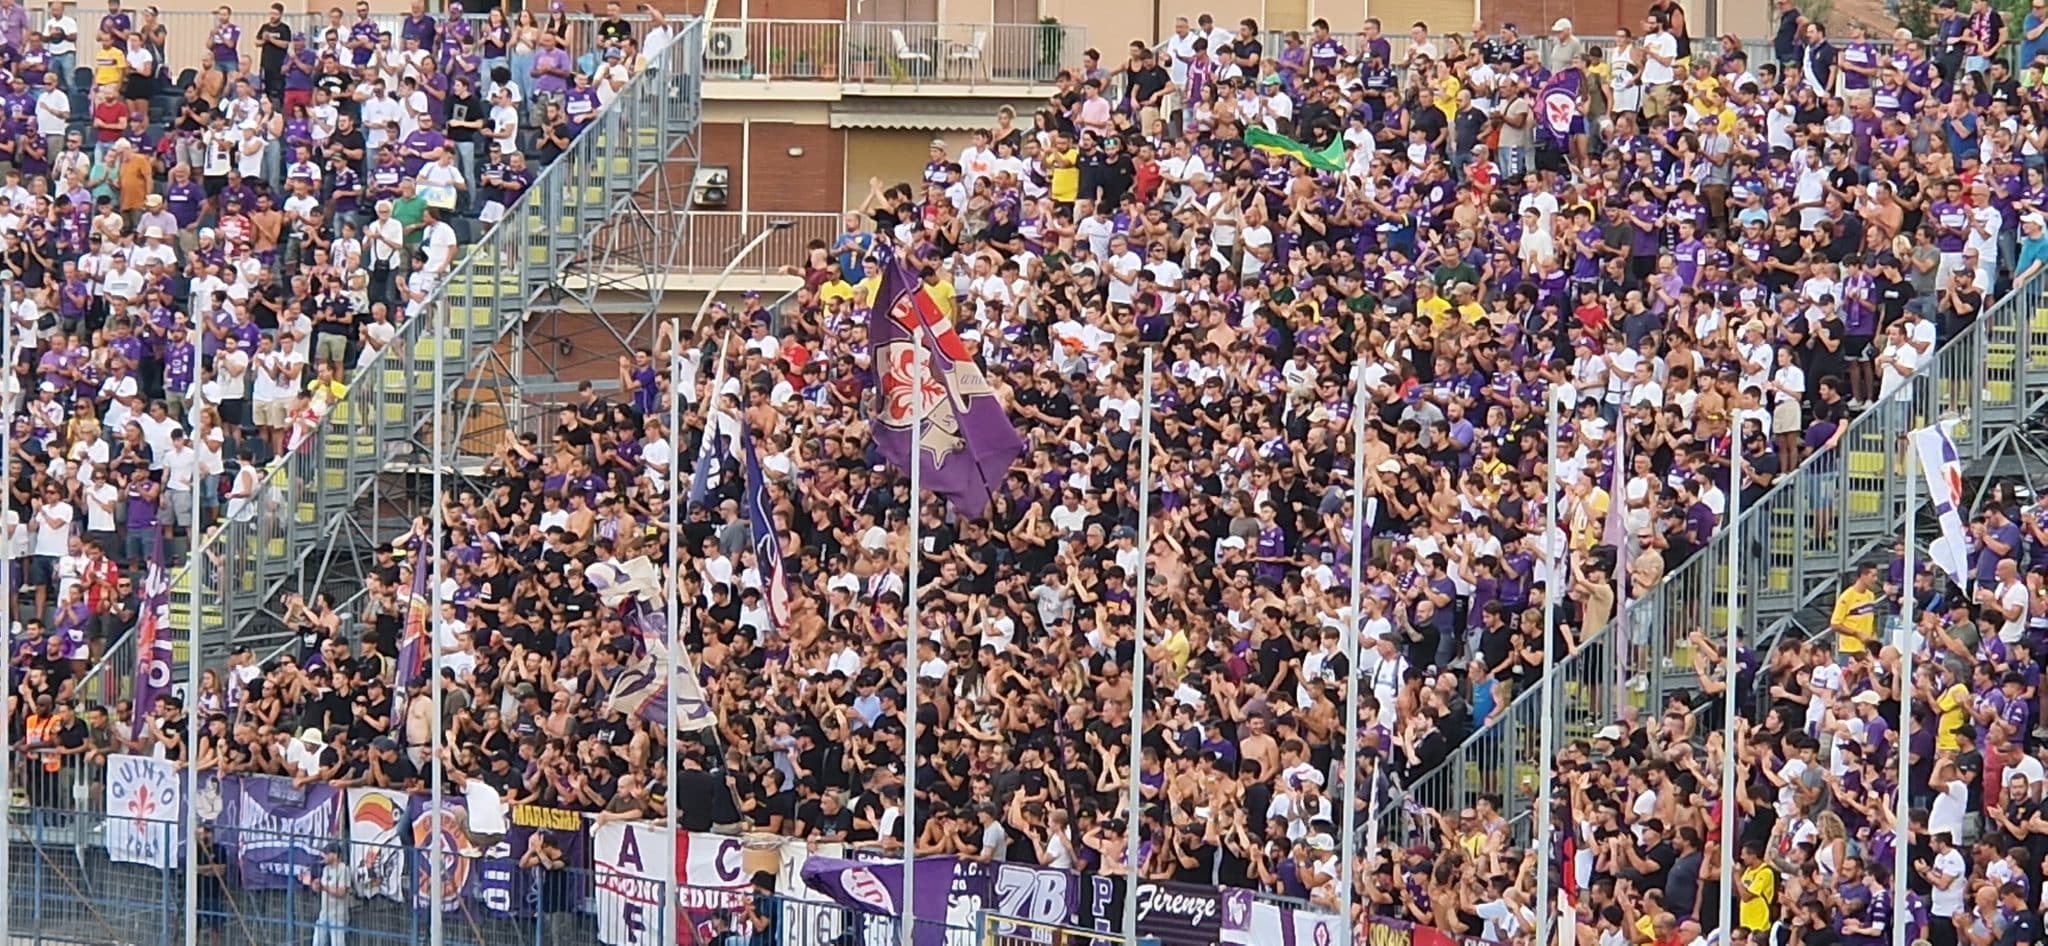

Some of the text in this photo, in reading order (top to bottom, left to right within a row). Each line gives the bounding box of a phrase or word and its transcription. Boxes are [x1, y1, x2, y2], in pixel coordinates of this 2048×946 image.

[111, 758, 175, 806] QUINTO
[512, 804, 581, 831] MARASMA
[994, 865, 1069, 935] 7B
[1135, 883, 1216, 927] Firenze
